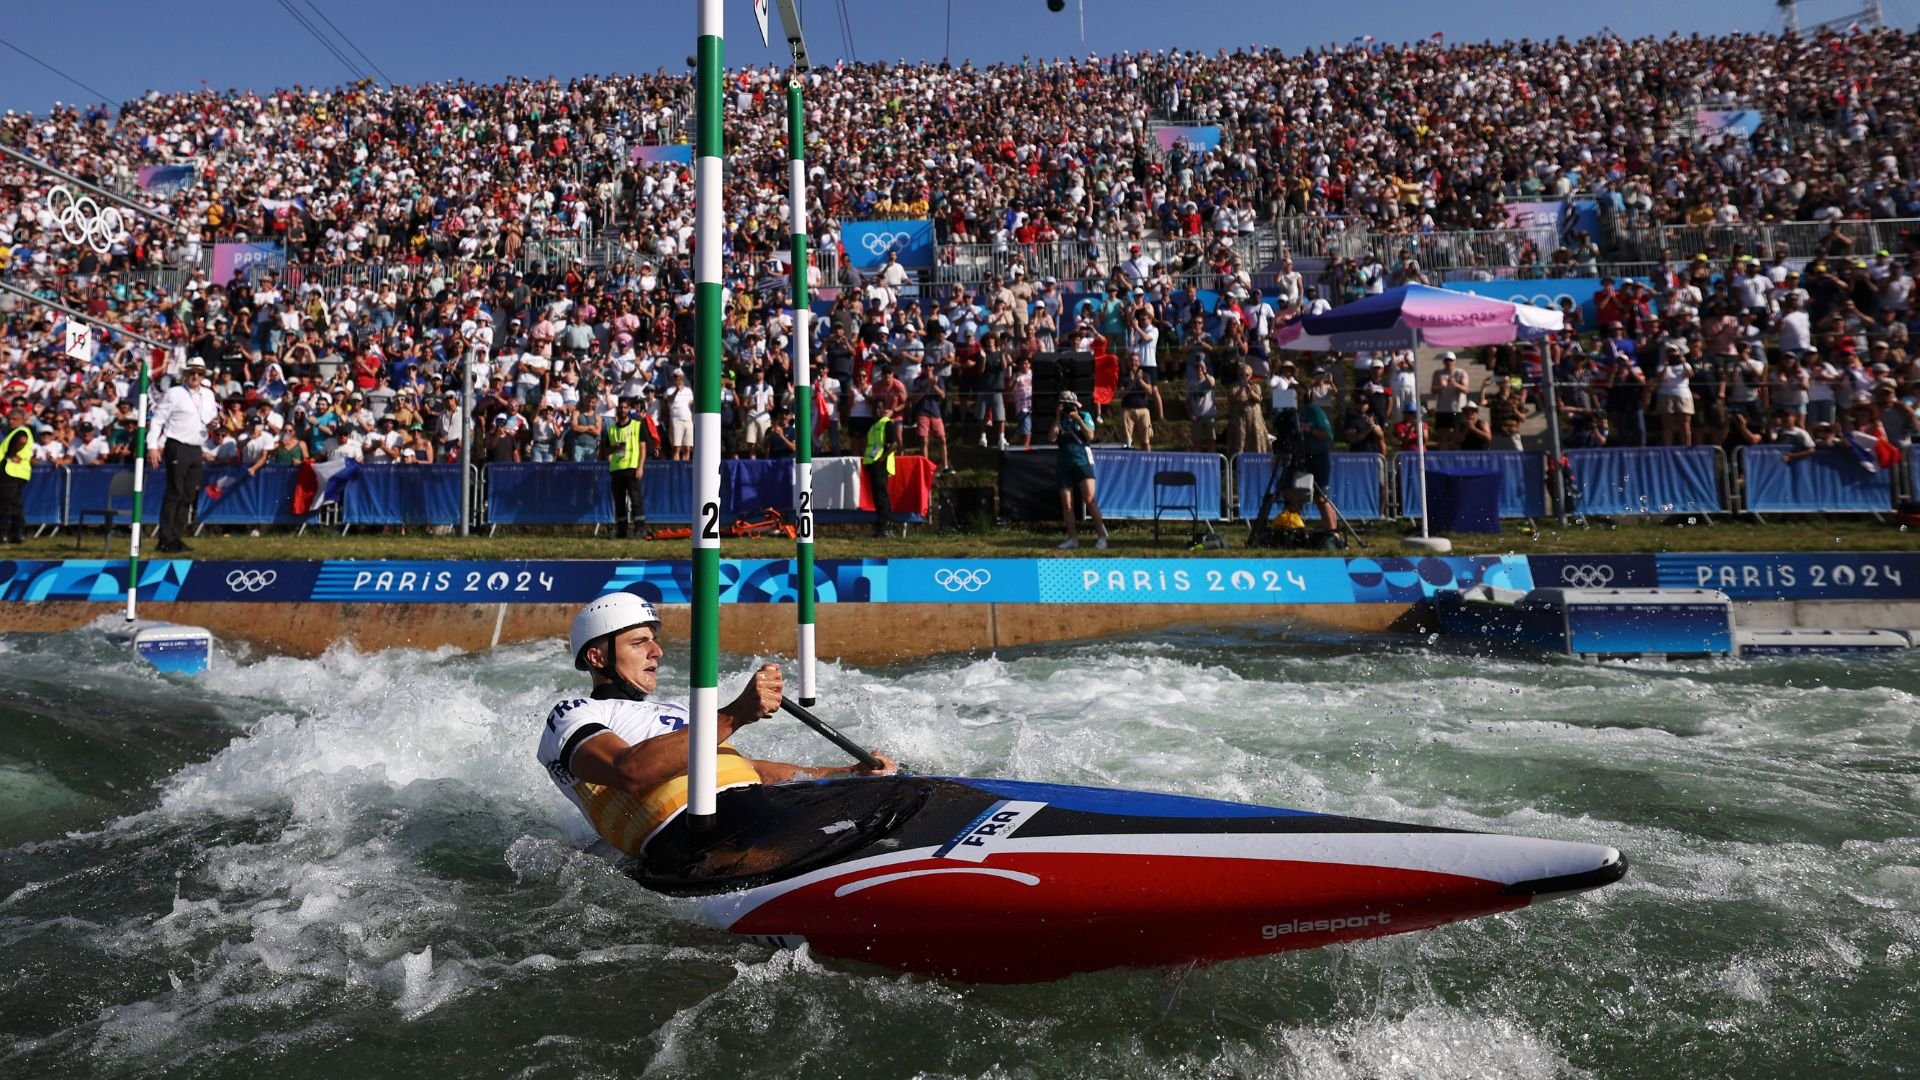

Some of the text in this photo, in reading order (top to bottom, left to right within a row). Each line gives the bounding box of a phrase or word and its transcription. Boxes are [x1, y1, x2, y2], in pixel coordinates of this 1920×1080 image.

[702, 502, 720, 539] 2
[961, 811, 1021, 847] FRA
[1262, 911, 1391, 940] galasport
